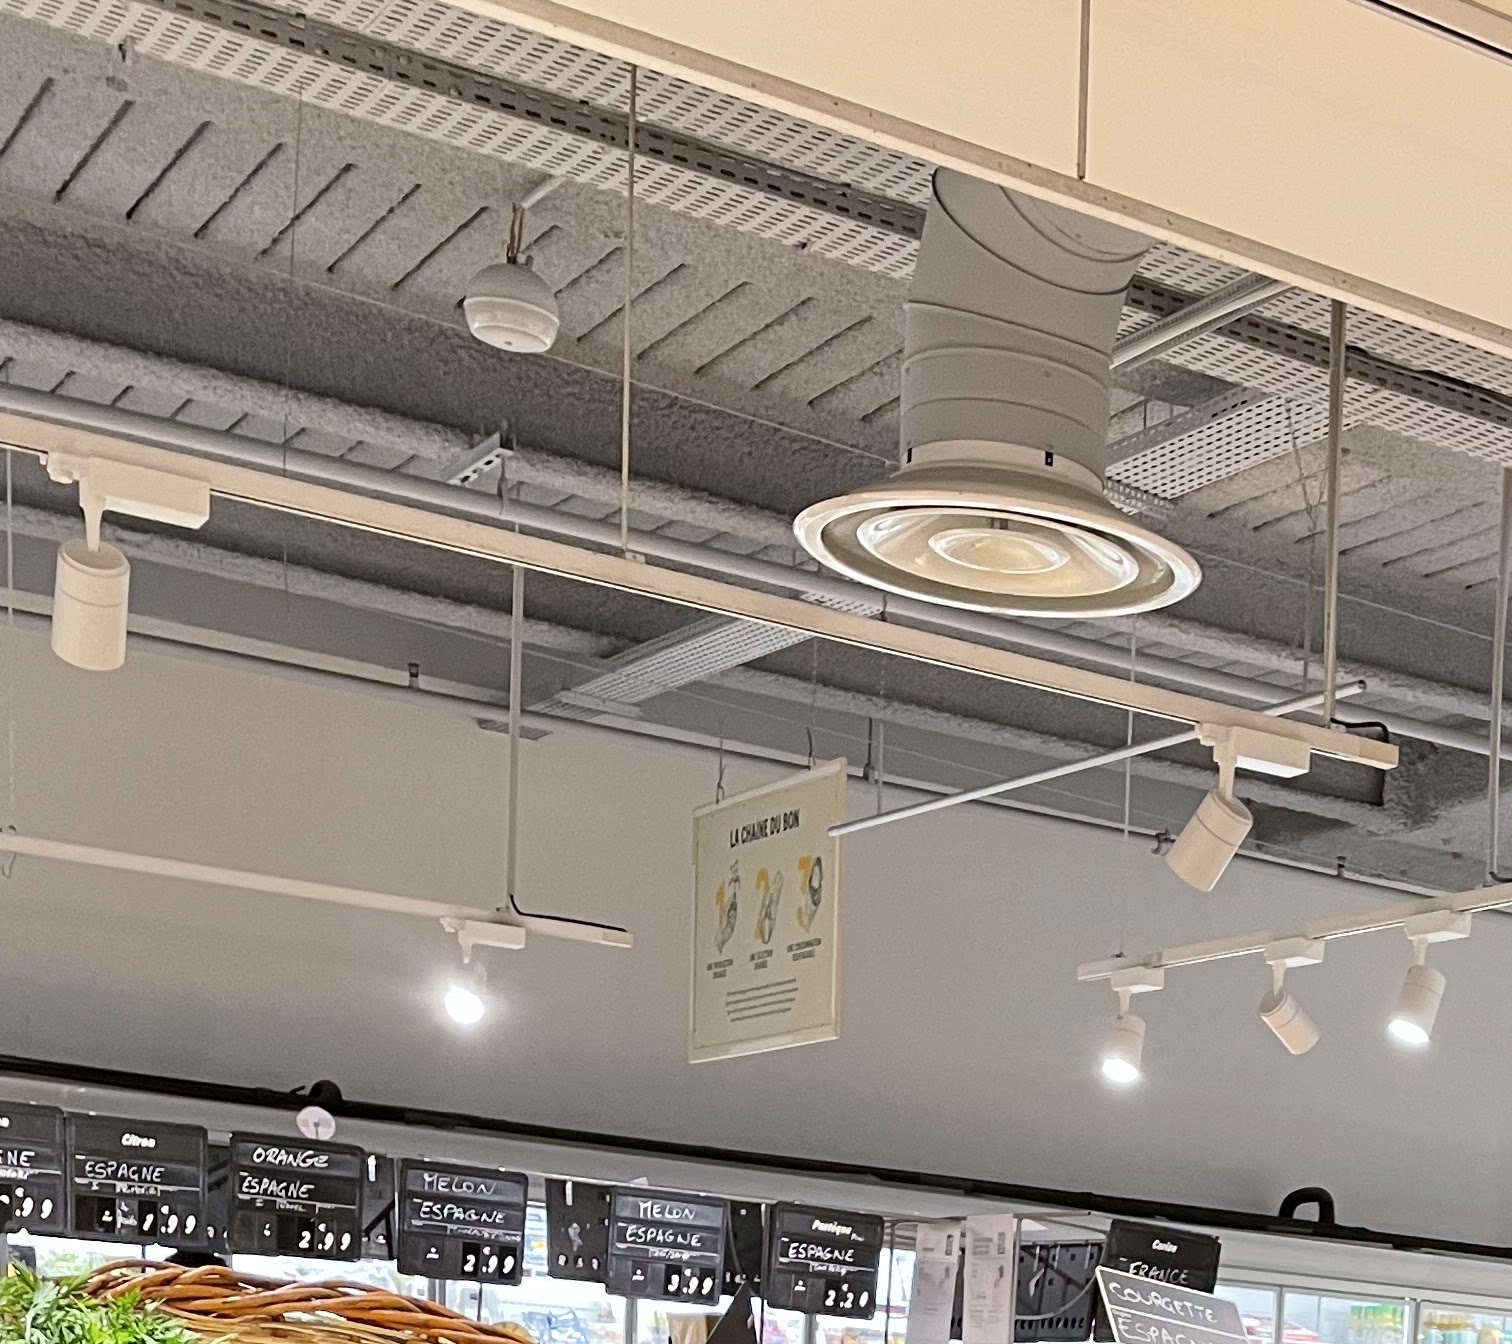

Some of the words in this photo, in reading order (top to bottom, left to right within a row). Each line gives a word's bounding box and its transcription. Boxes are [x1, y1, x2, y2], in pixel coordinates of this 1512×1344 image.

[729, 828, 740, 849] LA
[769, 815, 781, 836] DU
[782, 807, 800, 832] BON
[252, 1147, 329, 1168] ORANGE
[84, 1160, 165, 1182] ESPAGNE
[241, 1175, 315, 1199] ESPAGNE
[423, 1172, 497, 1196] MELON
[419, 1200, 507, 1224] ESPAGNE
[638, 1200, 697, 1221] MELON
[625, 1225, 702, 1247] ESPAGNE
[788, 1242, 855, 1263] ESPAGNE
[1128, 1261, 1191, 1285] FRANCE
[1108, 1281, 1219, 1324] COURGETTE
